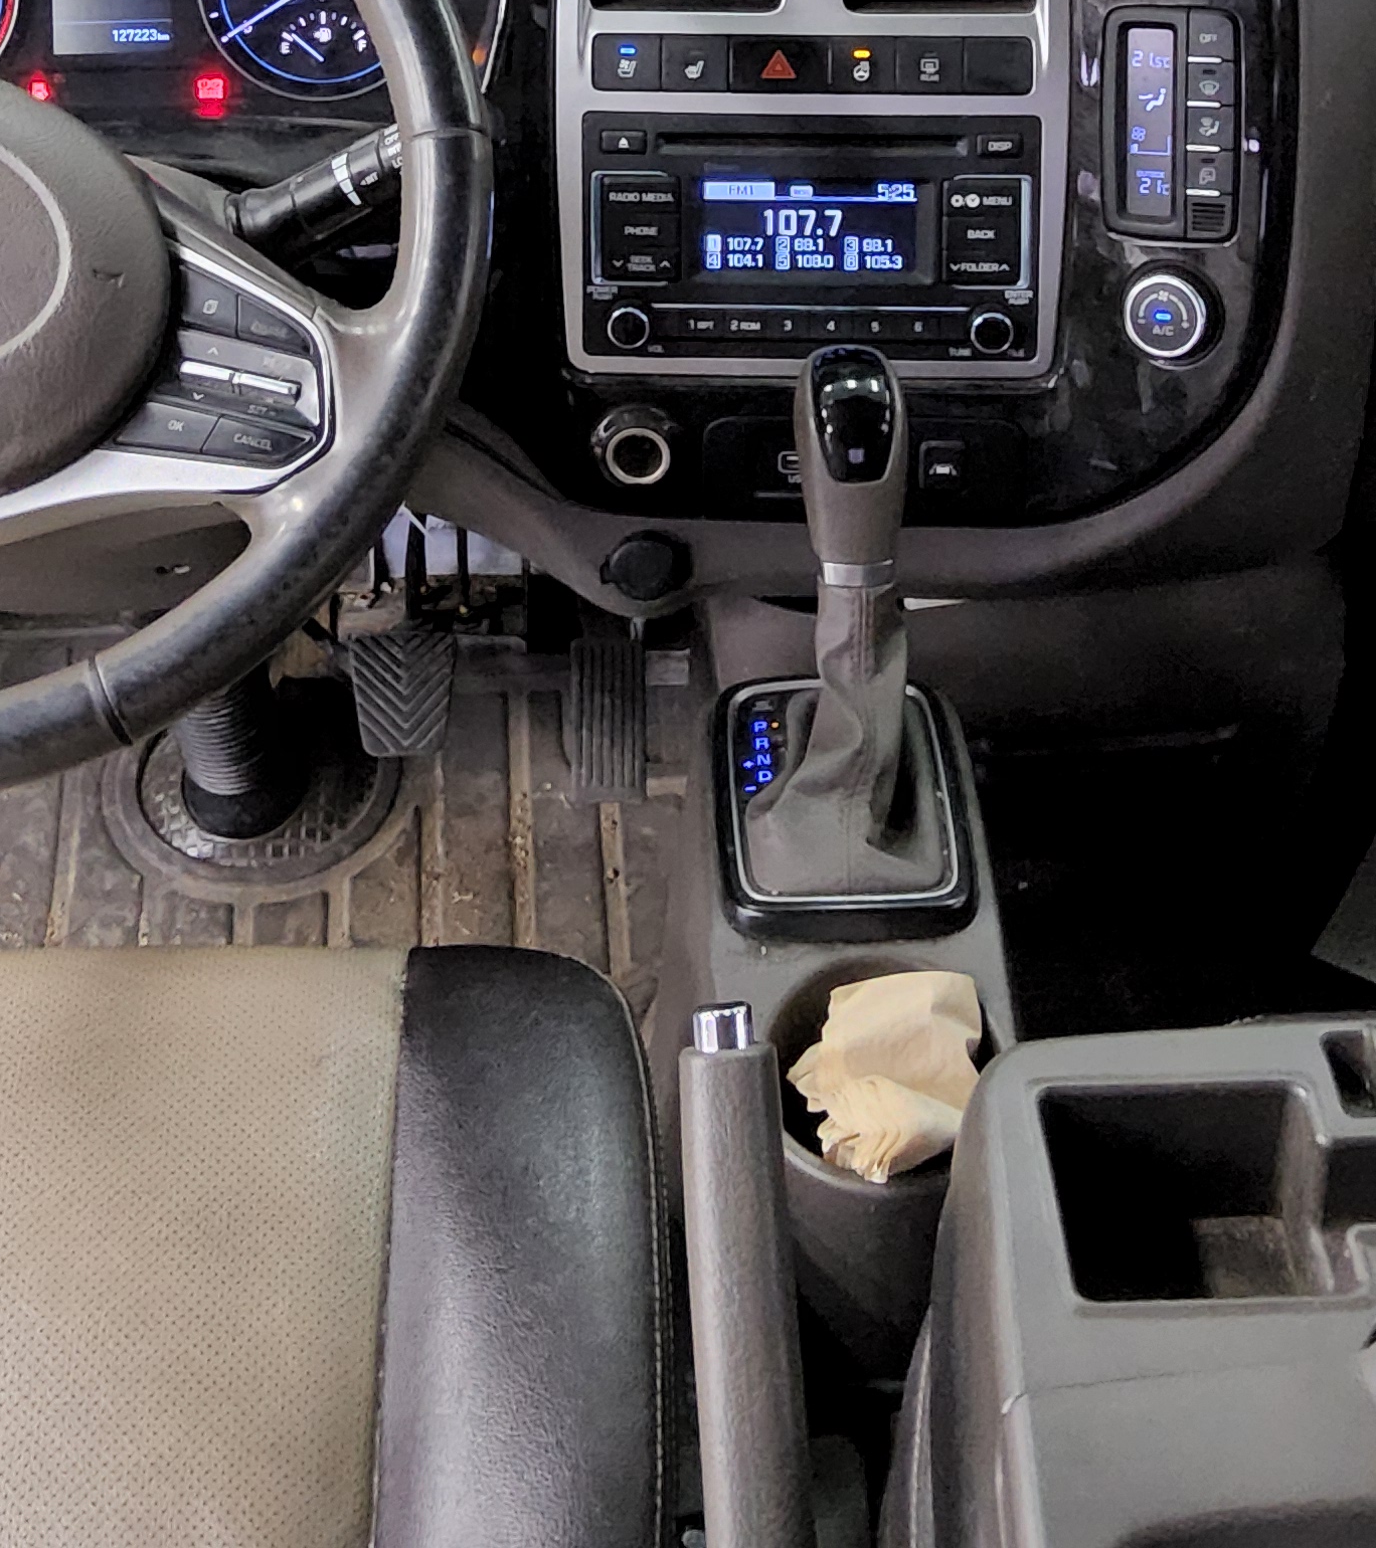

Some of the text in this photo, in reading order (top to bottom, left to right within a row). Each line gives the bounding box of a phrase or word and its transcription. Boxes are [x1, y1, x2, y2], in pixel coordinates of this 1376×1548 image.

[1198, 32, 1218, 43] OFF
[280, 41, 291, 54] E
[356, 38, 368, 53] F
[728, 184, 755, 196] FM1
[608, 192, 674, 202] RADIO MEDIA
[982, 196, 1013, 206] MENU
[763, 208, 843, 237] 107.7
[624, 226, 658, 236] PHONE
[966, 229, 996, 239] BACK
[726, 237, 764, 251] 107.7
[960, 262, 999, 272] FOLDER
[688, 319, 695, 331] 1
[729, 319, 739, 331] 2
[783, 320, 793, 331] 3
[826, 320, 836, 332] 4
[870, 321, 880, 333] 5
[914, 321, 923, 333] 6
[1152, 324, 1174, 337] A/C
[168, 419, 184, 432] OK
[233, 432, 273, 451] CANCEL
[753, 720, 768, 733] P
[755, 737, 770, 750] R
[756, 753, 772, 767] N
[757, 769, 773, 783] D
